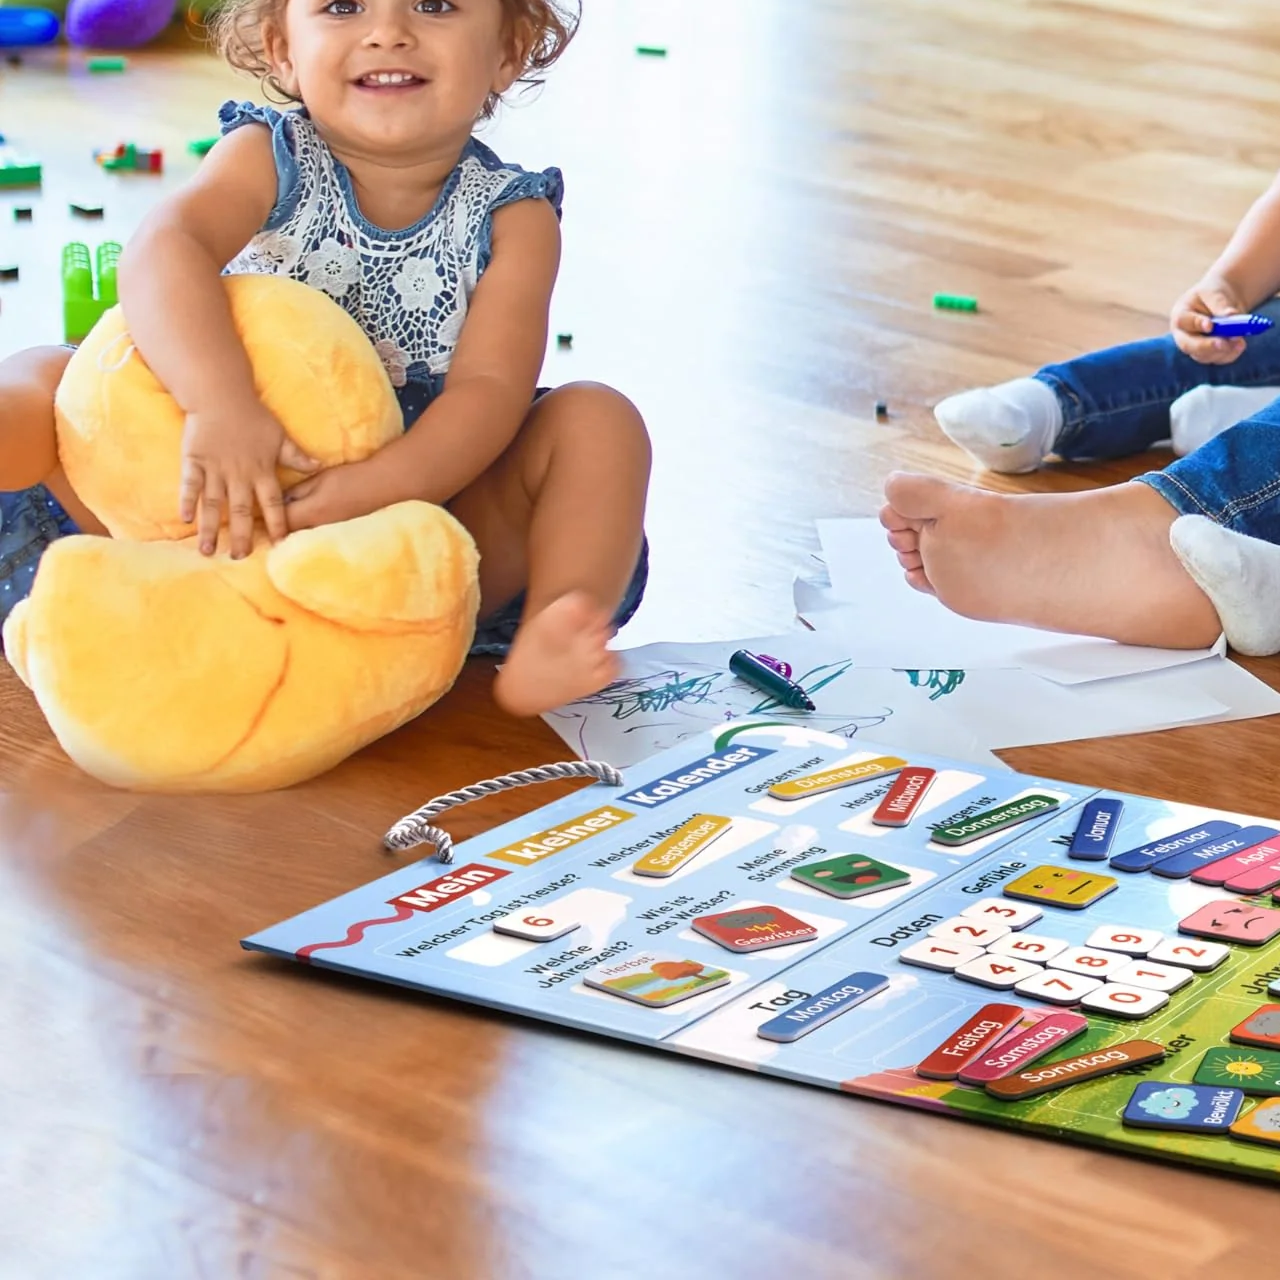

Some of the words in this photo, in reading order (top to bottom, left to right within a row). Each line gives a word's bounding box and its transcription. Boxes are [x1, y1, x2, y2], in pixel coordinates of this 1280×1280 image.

[744, 768, 800, 794] Gestern
[797, 755, 825, 769] war
[795, 763, 885, 788] Dienstag
[840, 786, 886, 810] Heute
[887, 775, 927, 813] Mittwoch
[977, 795, 998, 807] ist
[400, 868, 496, 908] Mein
[505, 808, 622, 859] kleiner
[627, 745, 759, 808] Kalender
[944, 797, 1049, 837] Donnerstag
[1084, 810, 1112, 841] Januar
[588, 839, 654, 868] Welcher
[649, 819, 719, 866] September
[736, 847, 787, 872] Meine
[1140, 829, 1211, 857] Februar
[1193, 838, 1245, 860] März
[1239, 846, 1279, 867] April
[747, 845, 828, 883] Stimmung
[961, 860, 1027, 895] Gefühle
[396, 923, 471, 957] Welcher
[467, 906, 507, 927] Tag
[505, 897, 529, 912] ist
[528, 873, 582, 901] heute?
[523, 916, 554, 927] 6
[636, 902, 671, 921] Wie
[671, 894, 695, 906] ist
[646, 918, 679, 936] das
[676, 890, 736, 922] Wetter?
[734, 926, 815, 947] Gewitter
[869, 910, 944, 948] Daten
[929, 945, 959, 959] 1
[953, 925, 988, 939] 2
[984, 905, 1017, 919] 3
[525, 944, 593, 976] Welche
[539, 940, 635, 989] Jahreszeit?
[600, 956, 655, 977] Herbst
[988, 961, 1017, 976] 4
[1013, 941, 1046, 954] 5
[1043, 978, 1073, 992] 7
[1075, 954, 1108, 968] 8
[1111, 933, 1143, 946] 9
[1109, 992, 1141, 1004] 0
[1136, 968, 1167, 979] 1
[1172, 946, 1207, 959] 2
[748, 987, 813, 1013] Tag
[784, 983, 865, 1023] Montag
[941, 1017, 1004, 1058] Freitag
[995, 1022, 1069, 1070] Samstag
[1020, 1047, 1131, 1085] Sonntag
[1204, 1090, 1234, 1125] Bewölkt
